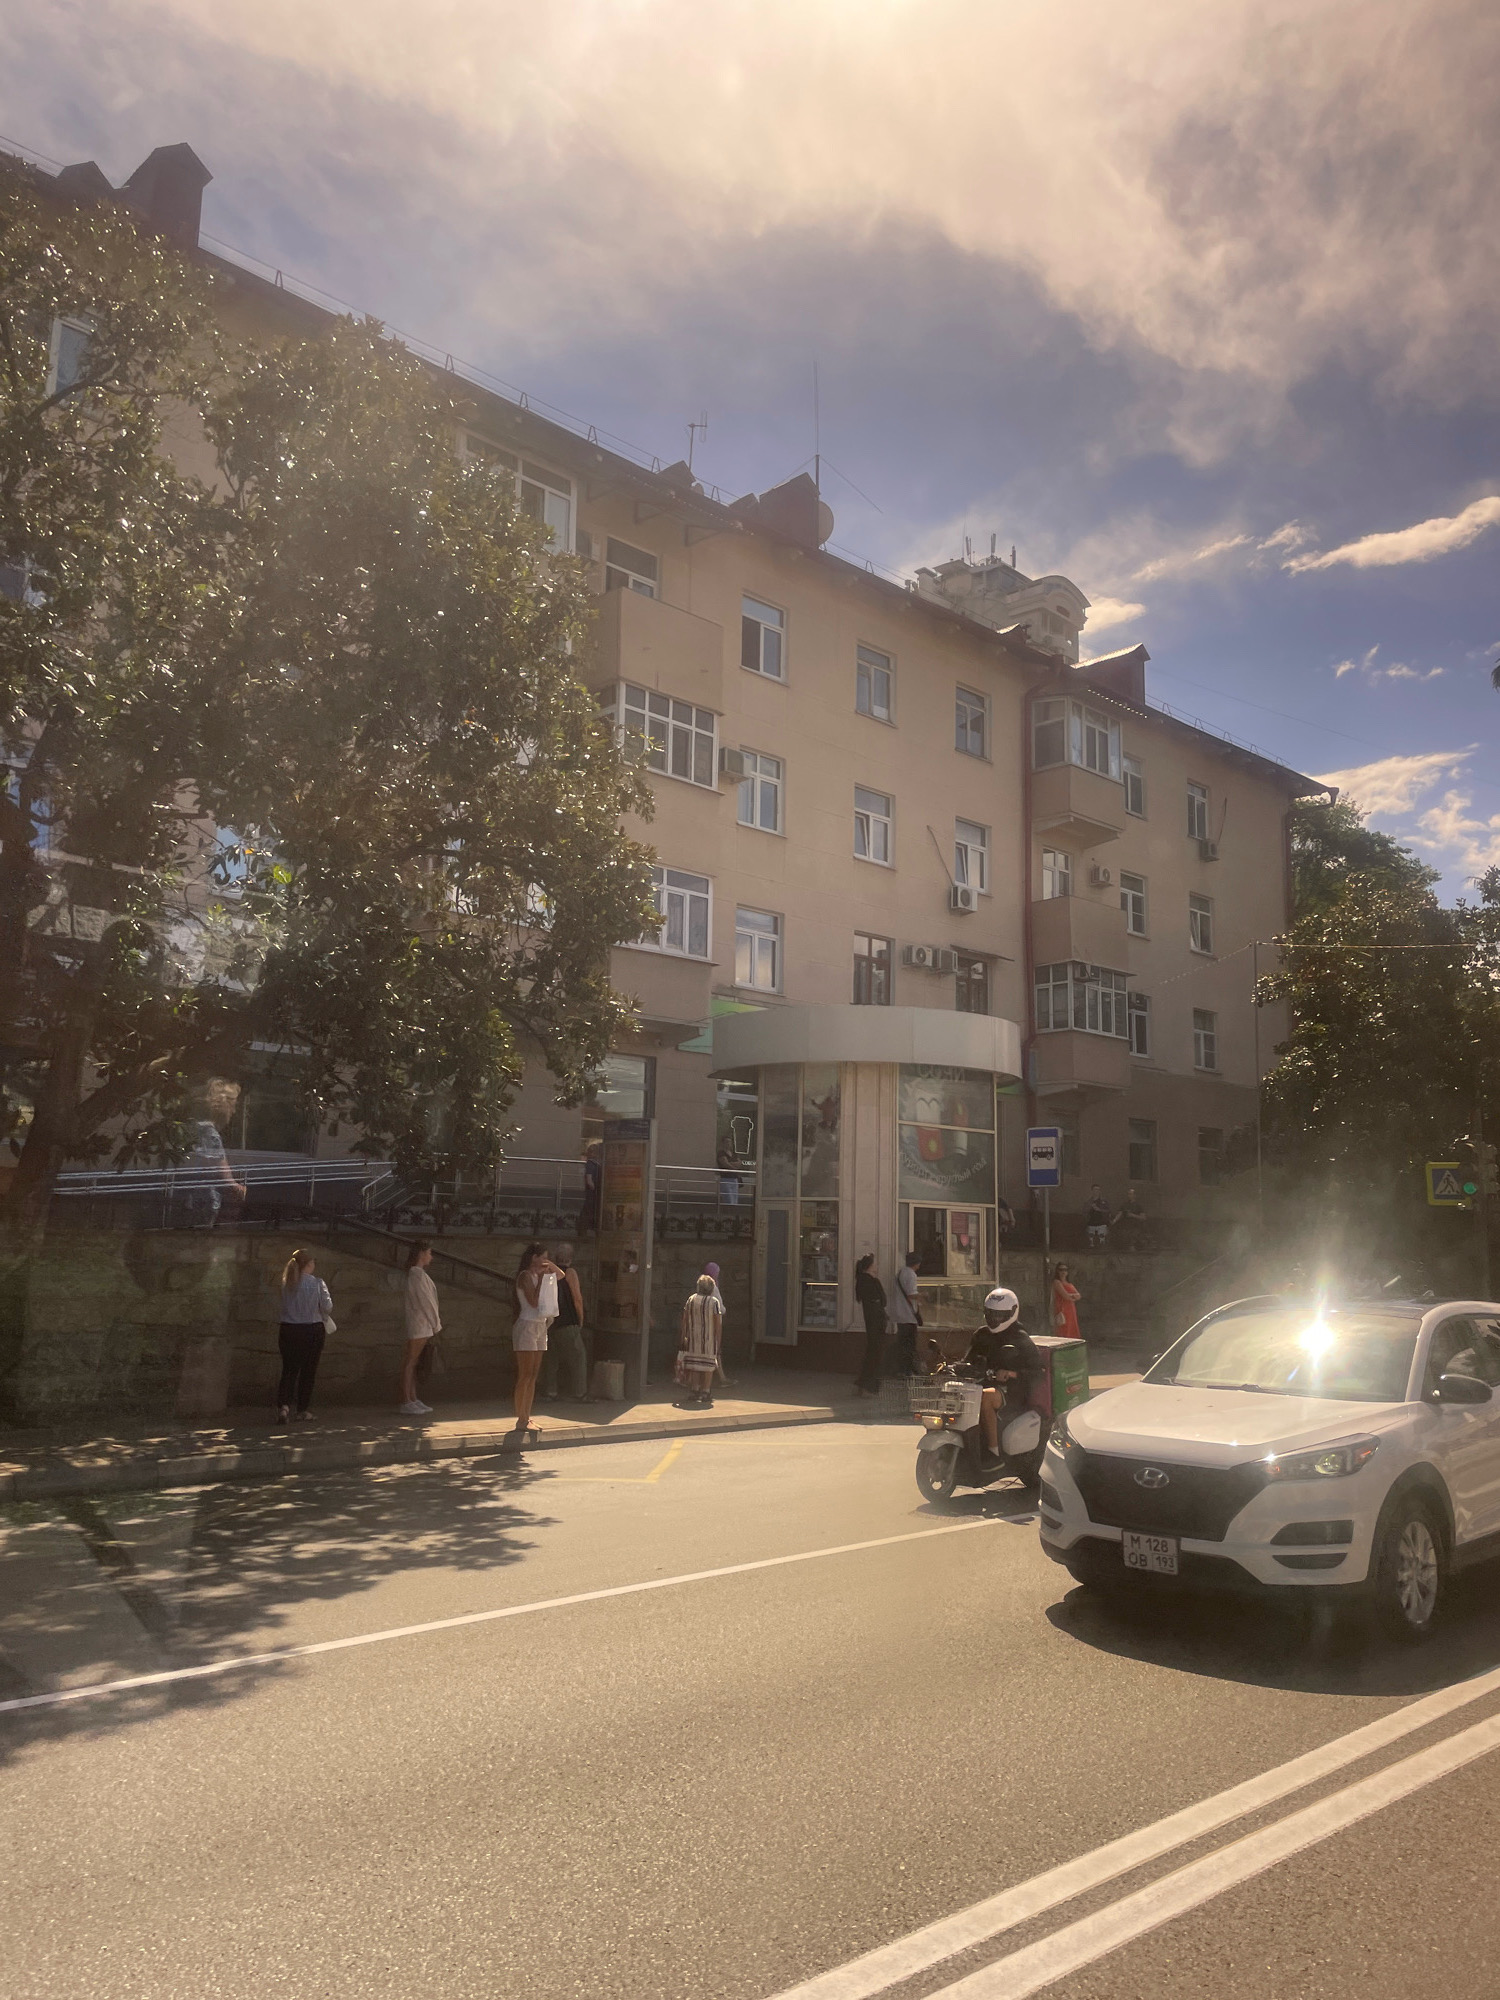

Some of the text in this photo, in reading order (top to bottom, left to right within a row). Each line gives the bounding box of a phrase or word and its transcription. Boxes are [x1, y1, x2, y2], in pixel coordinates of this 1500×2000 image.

[1130, 1535, 1169, 1553] М 128
[1128, 1552, 1175, 1568] ОВ 193
